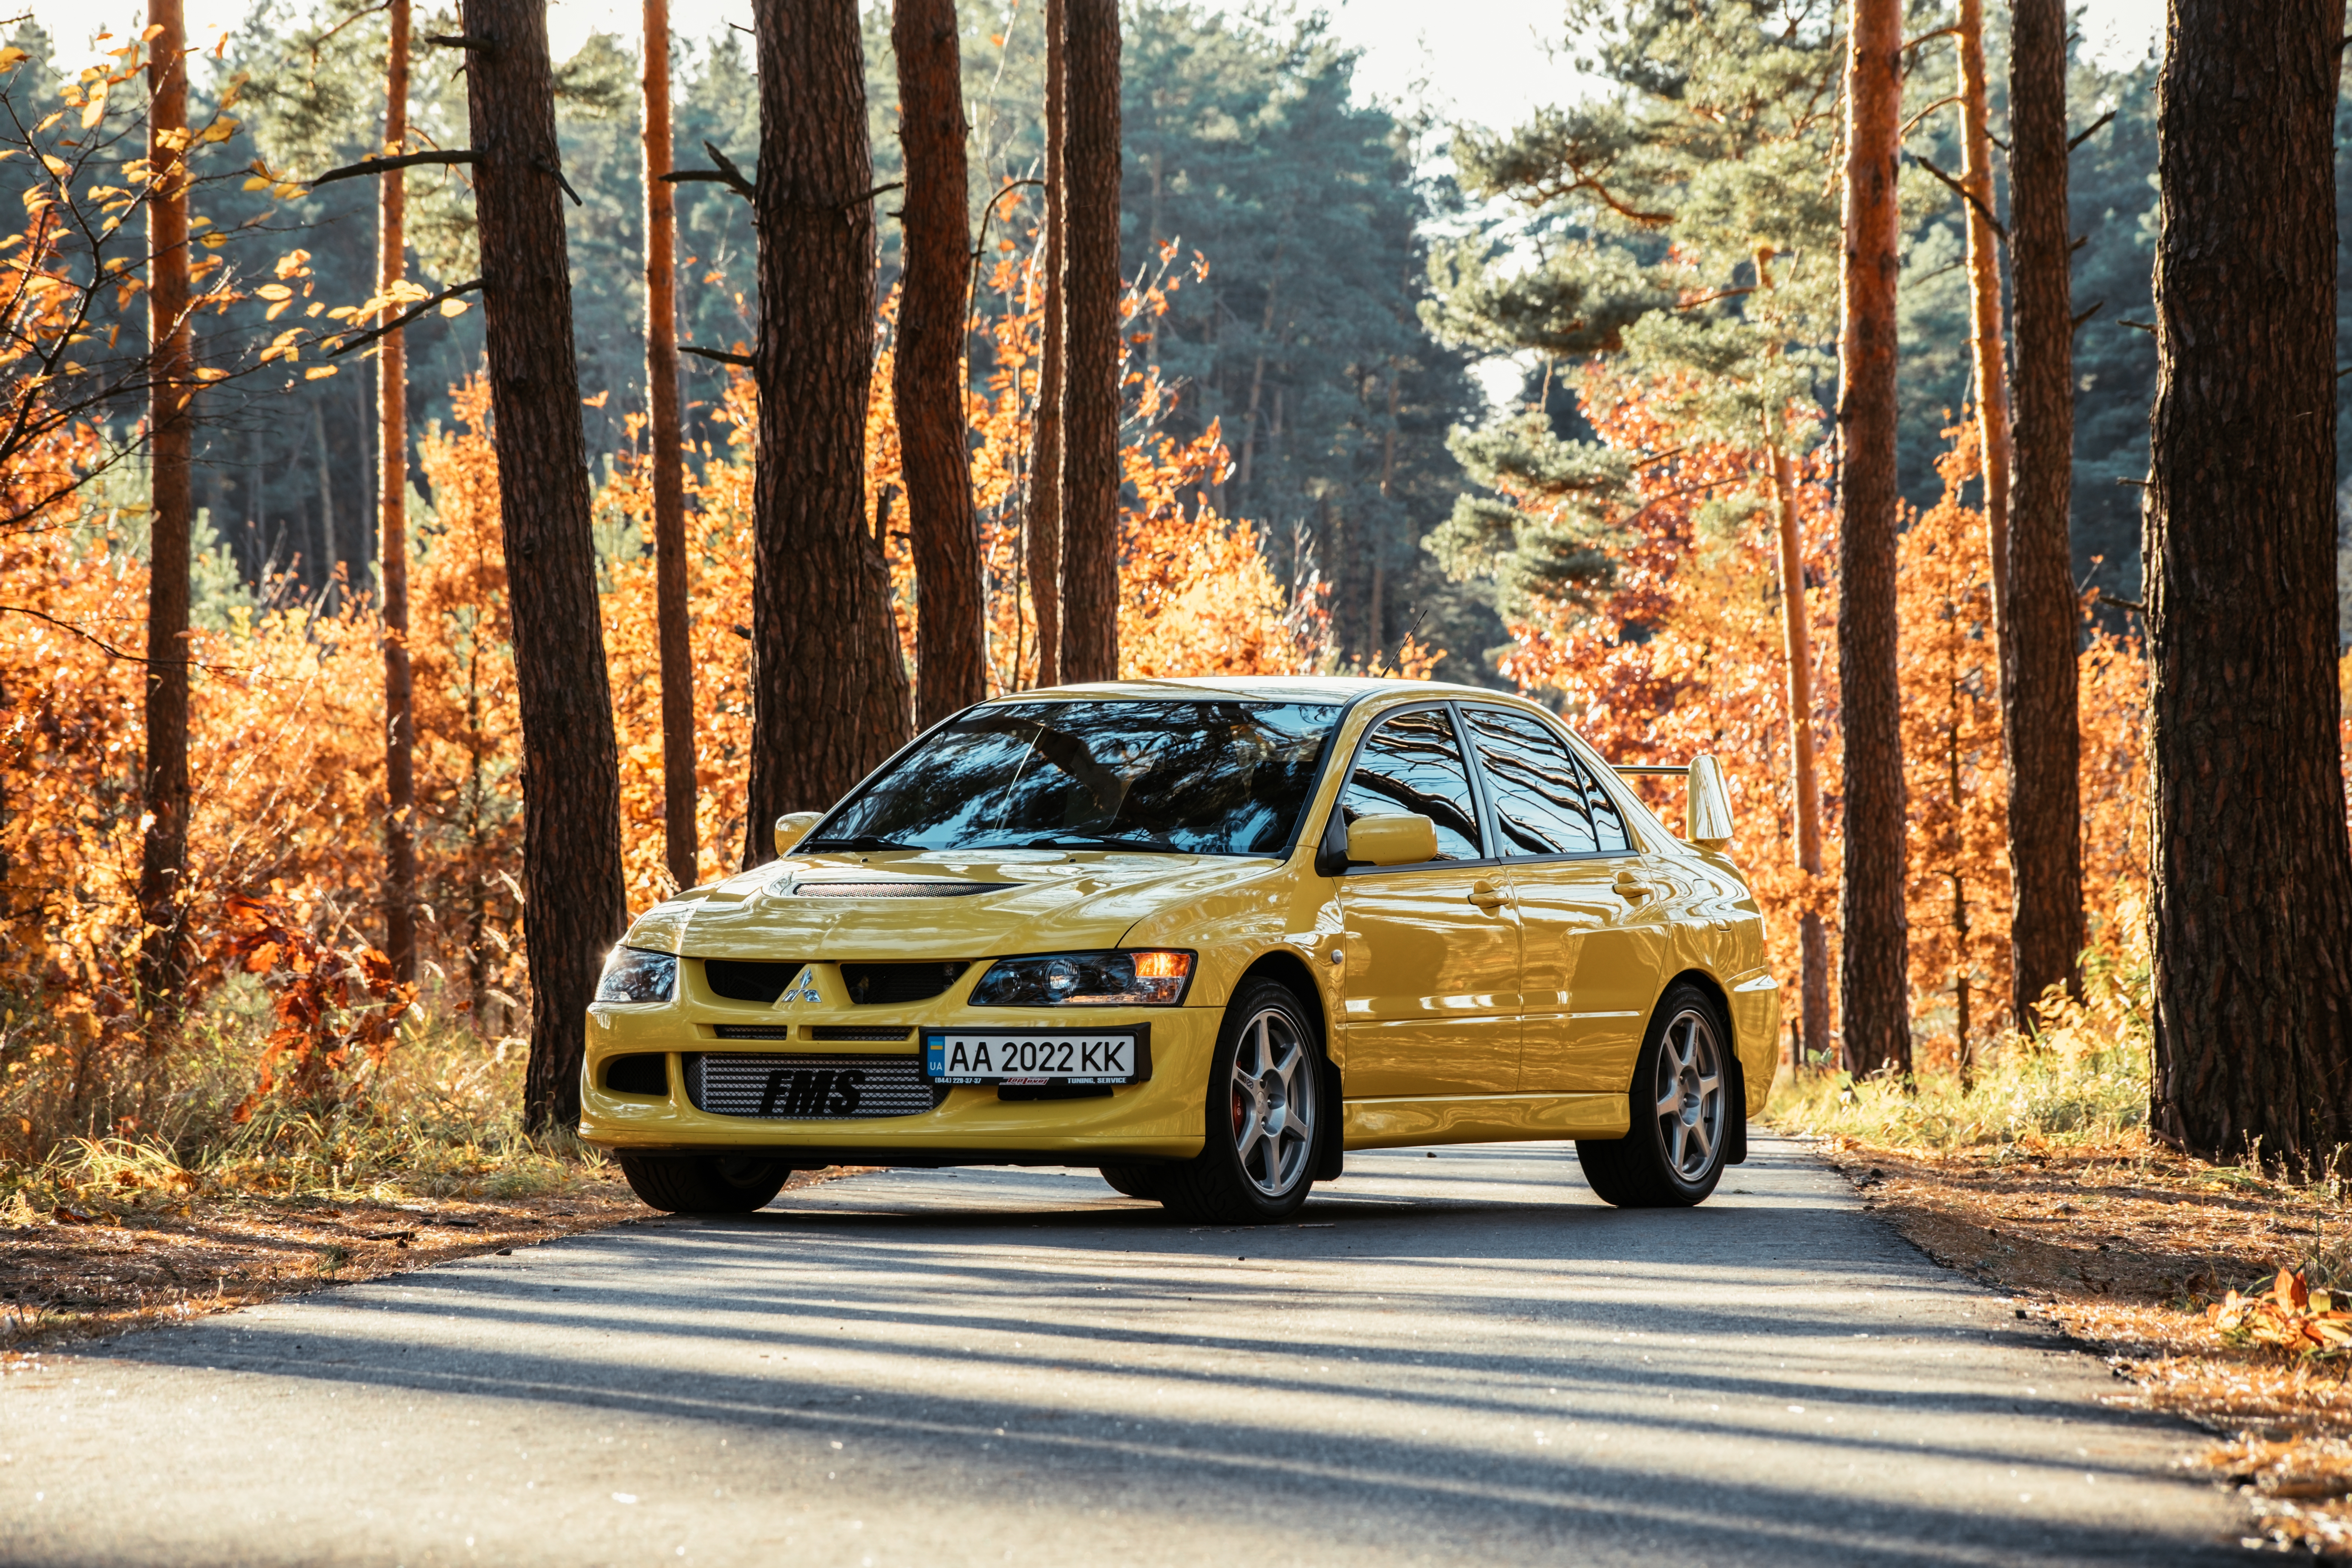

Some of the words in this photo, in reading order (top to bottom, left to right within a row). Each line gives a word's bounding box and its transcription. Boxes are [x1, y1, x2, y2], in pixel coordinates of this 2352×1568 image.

[930, 1062, 943, 1070] UA
[949, 1042, 992, 1071] AA
[1002, 1042, 1073, 1072] 2022
[1082, 1042, 1125, 1072] KK
[759, 1069, 866, 1115] FMS
